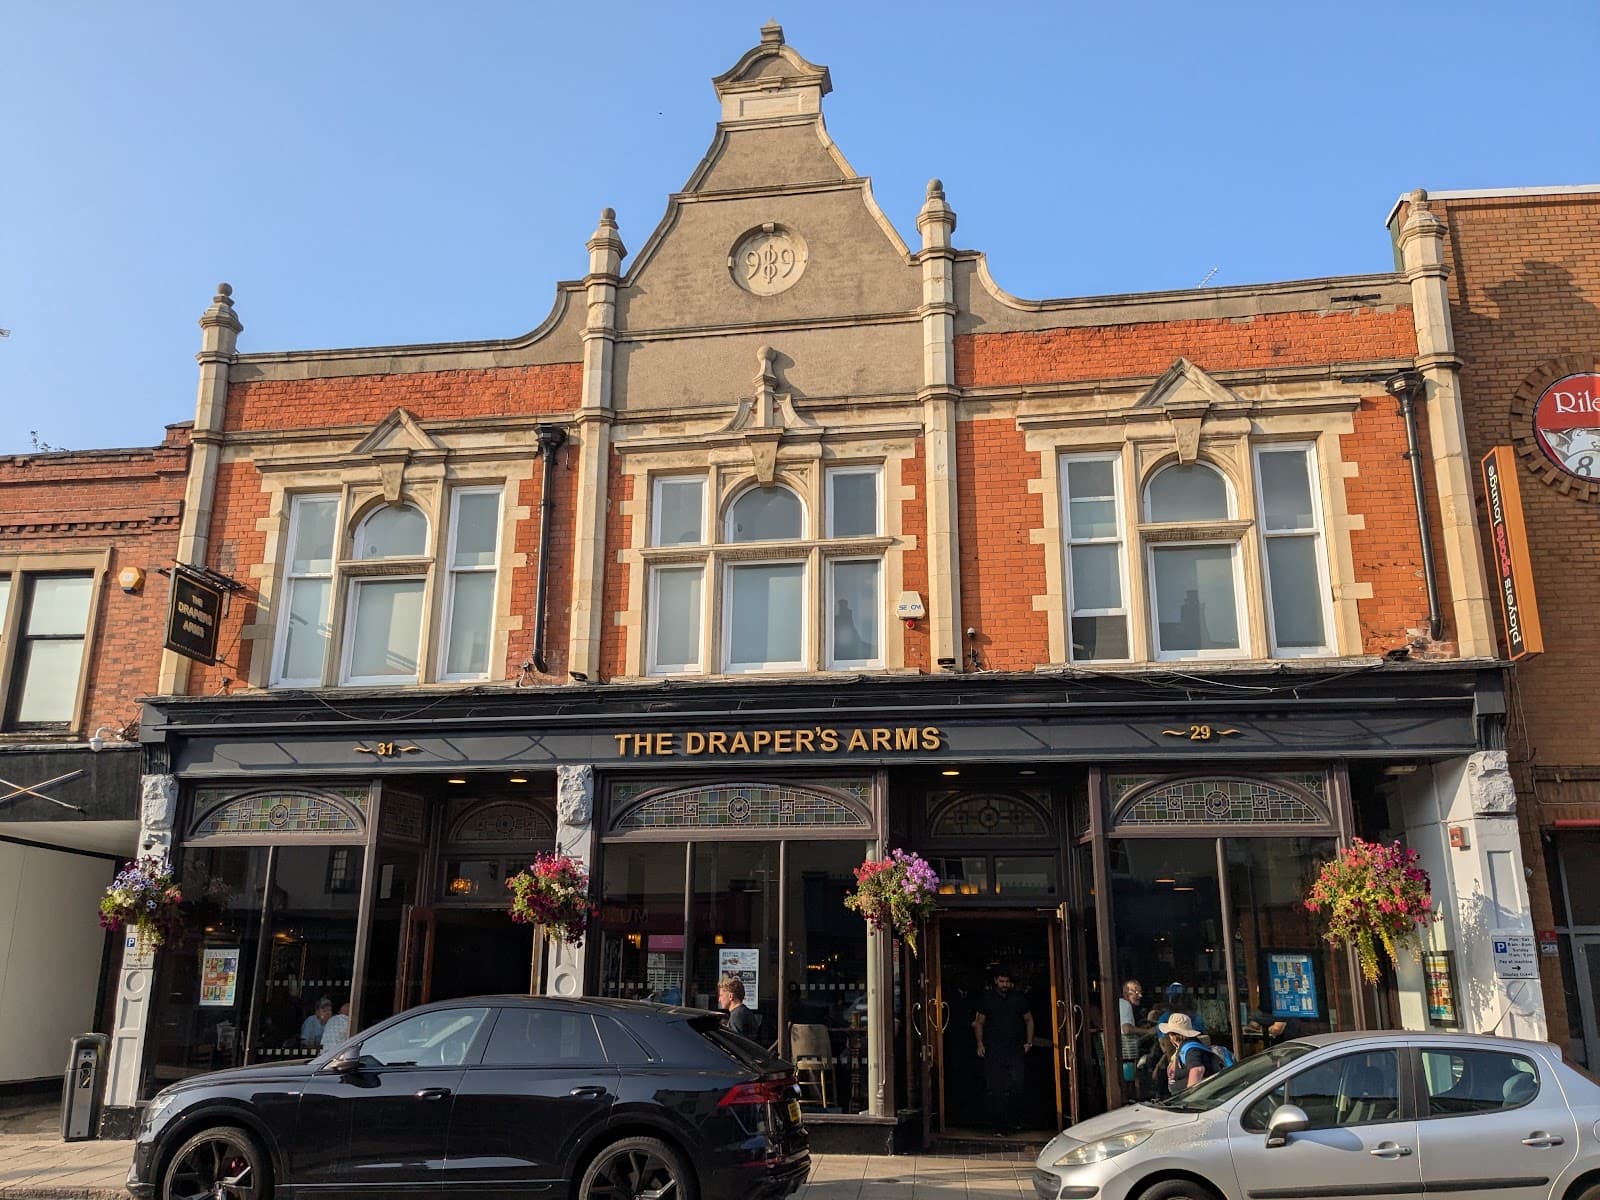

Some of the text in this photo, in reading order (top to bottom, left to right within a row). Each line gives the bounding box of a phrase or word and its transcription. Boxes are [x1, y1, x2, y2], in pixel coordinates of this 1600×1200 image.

[1488, 465, 1521, 645] players sports lounge
[614, 726, 942, 756] THE DRAPER'S ARMS
[1190, 725, 1211, 740] 29
[377, 742, 393, 755] 31
